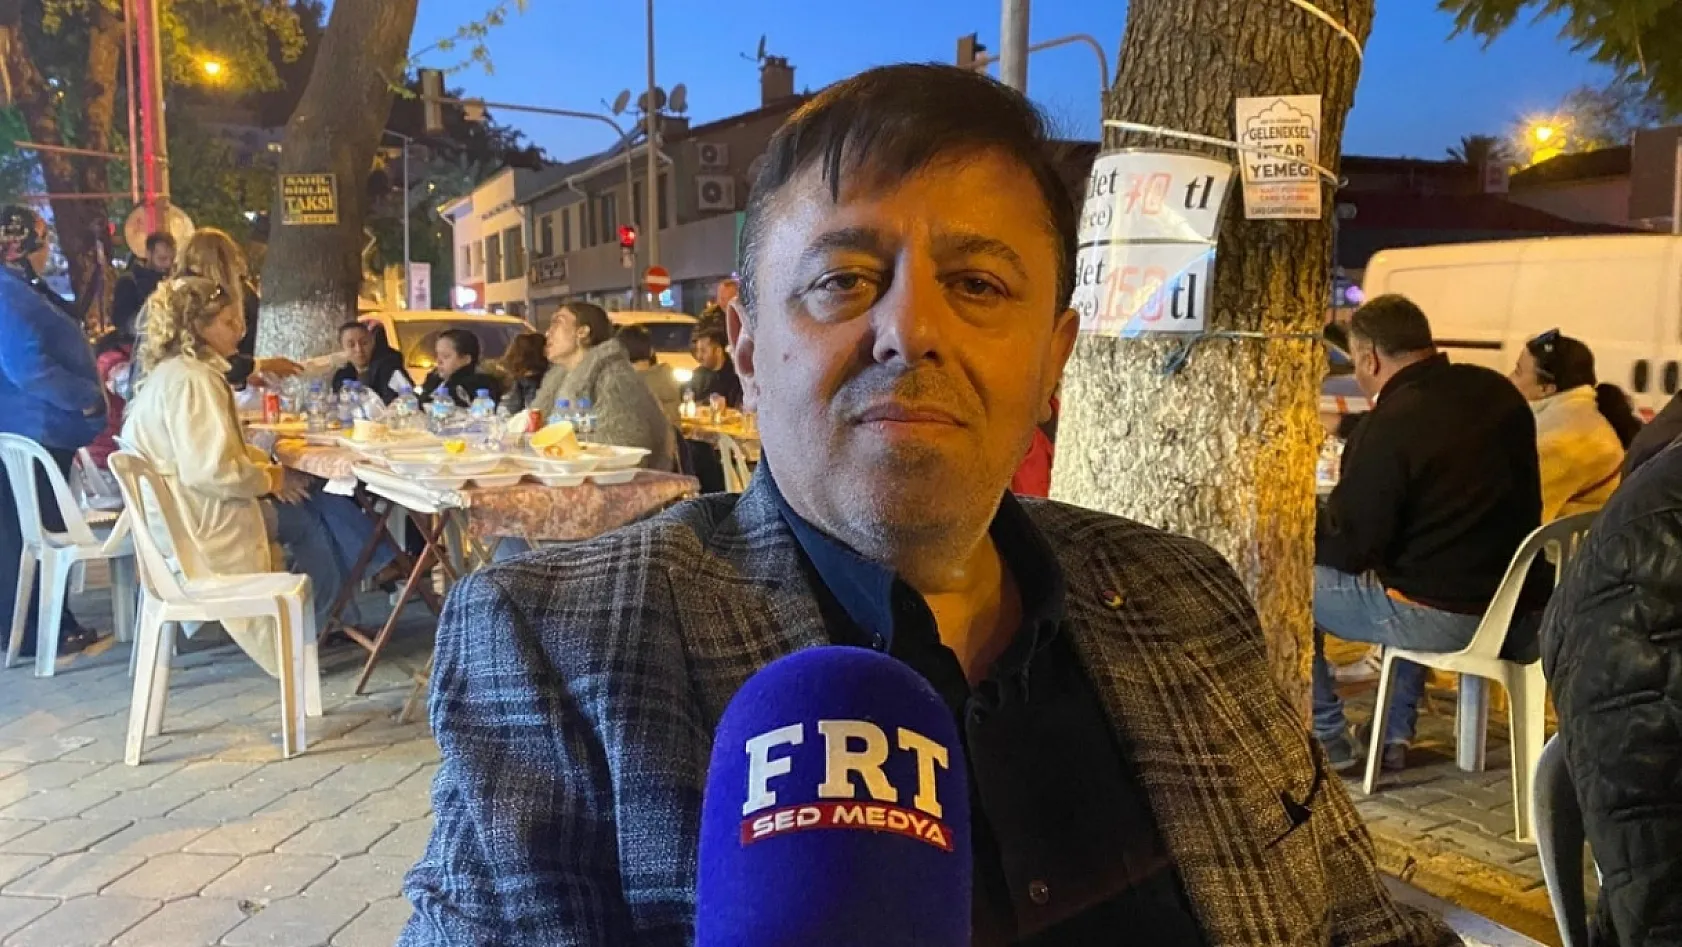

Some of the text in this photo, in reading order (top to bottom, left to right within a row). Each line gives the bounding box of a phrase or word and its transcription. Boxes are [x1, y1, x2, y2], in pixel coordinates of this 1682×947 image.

[1249, 126, 1310, 140] GELENEKSEL
[1124, 173, 1171, 215] 70
[1184, 175, 1215, 210] tl
[1099, 266, 1167, 322] 150
[1171, 272, 1197, 320] tl
[742, 719, 949, 819] FRT
[752, 805, 947, 847] SED MEDYA
